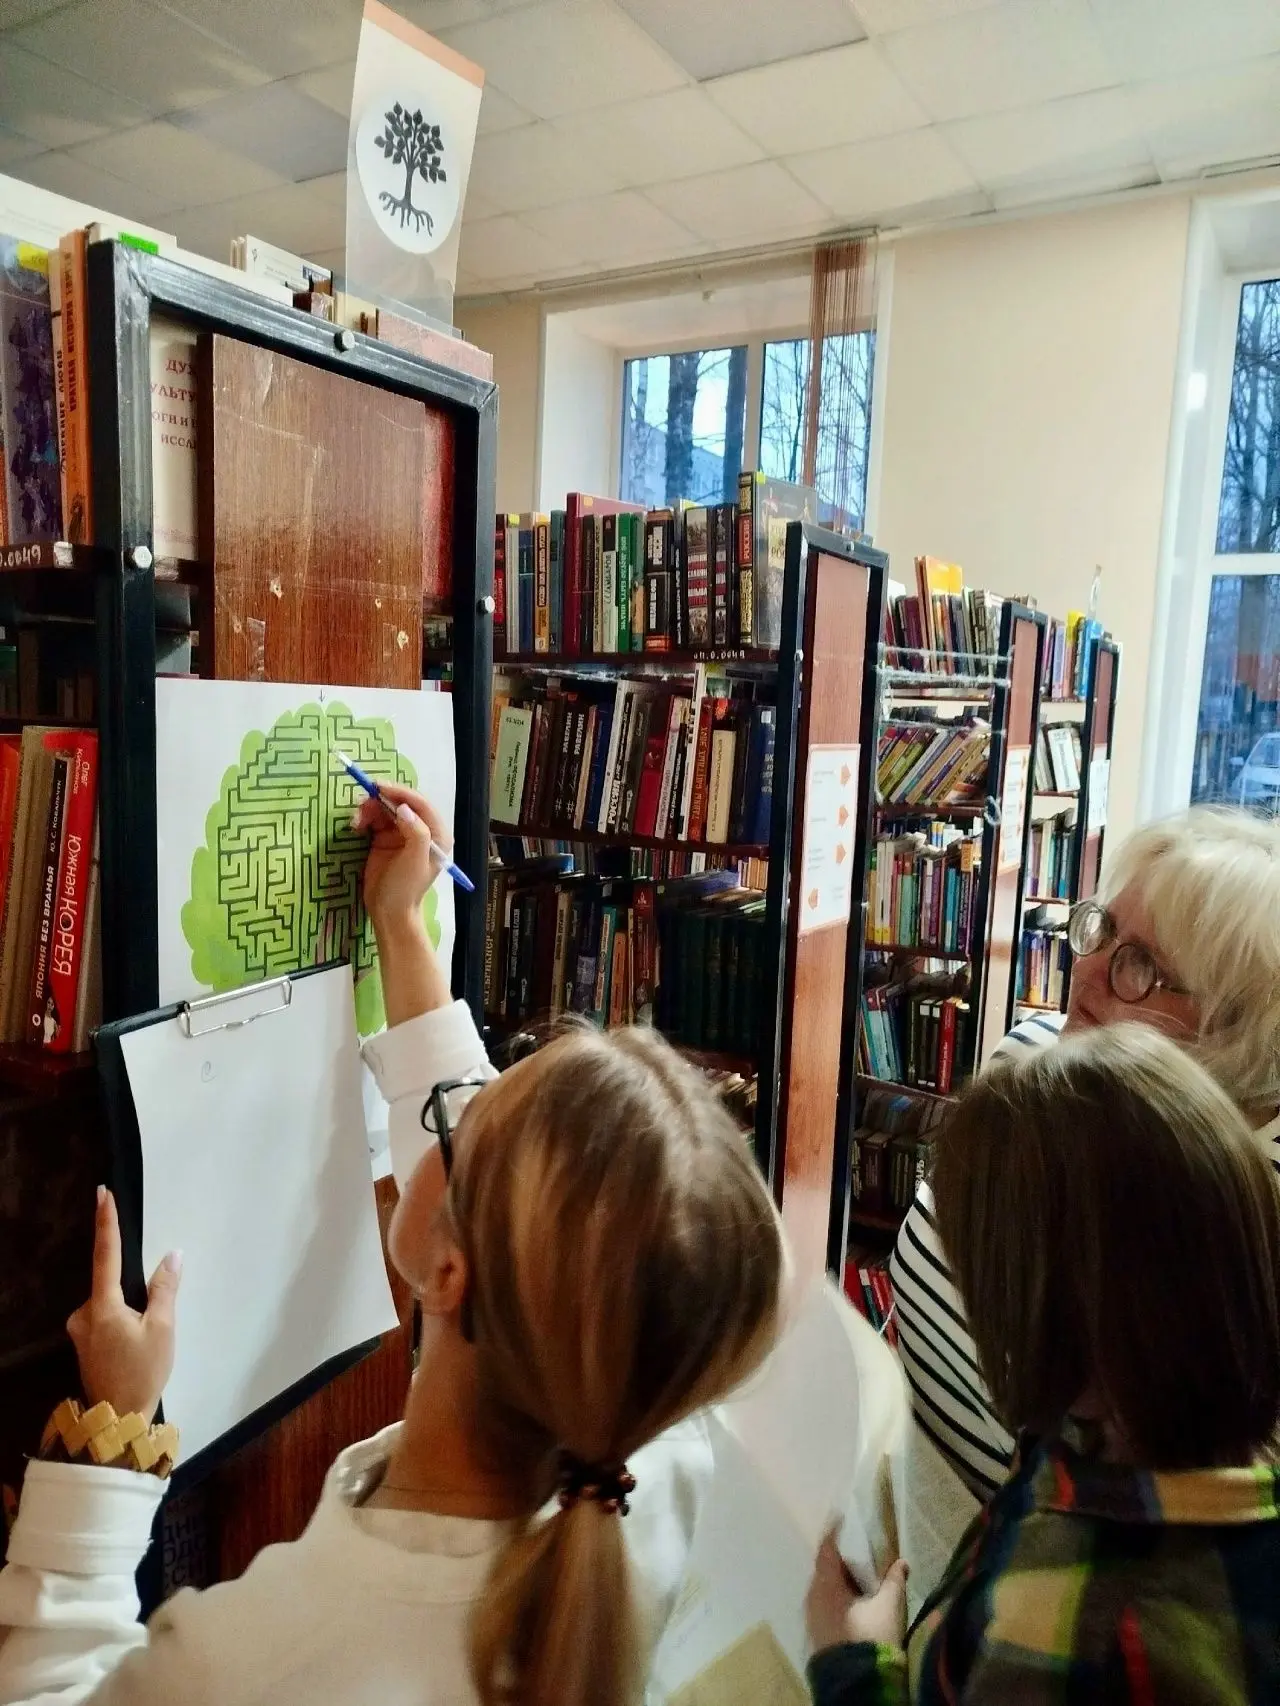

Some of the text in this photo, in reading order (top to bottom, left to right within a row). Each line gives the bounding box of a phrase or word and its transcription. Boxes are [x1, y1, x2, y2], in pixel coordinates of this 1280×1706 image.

[34, 865, 55, 1000] ЯПОНИЯ БЕЗ ВРАНЬЯ
[52, 833, 82, 976] Южная КОРЕЯ
